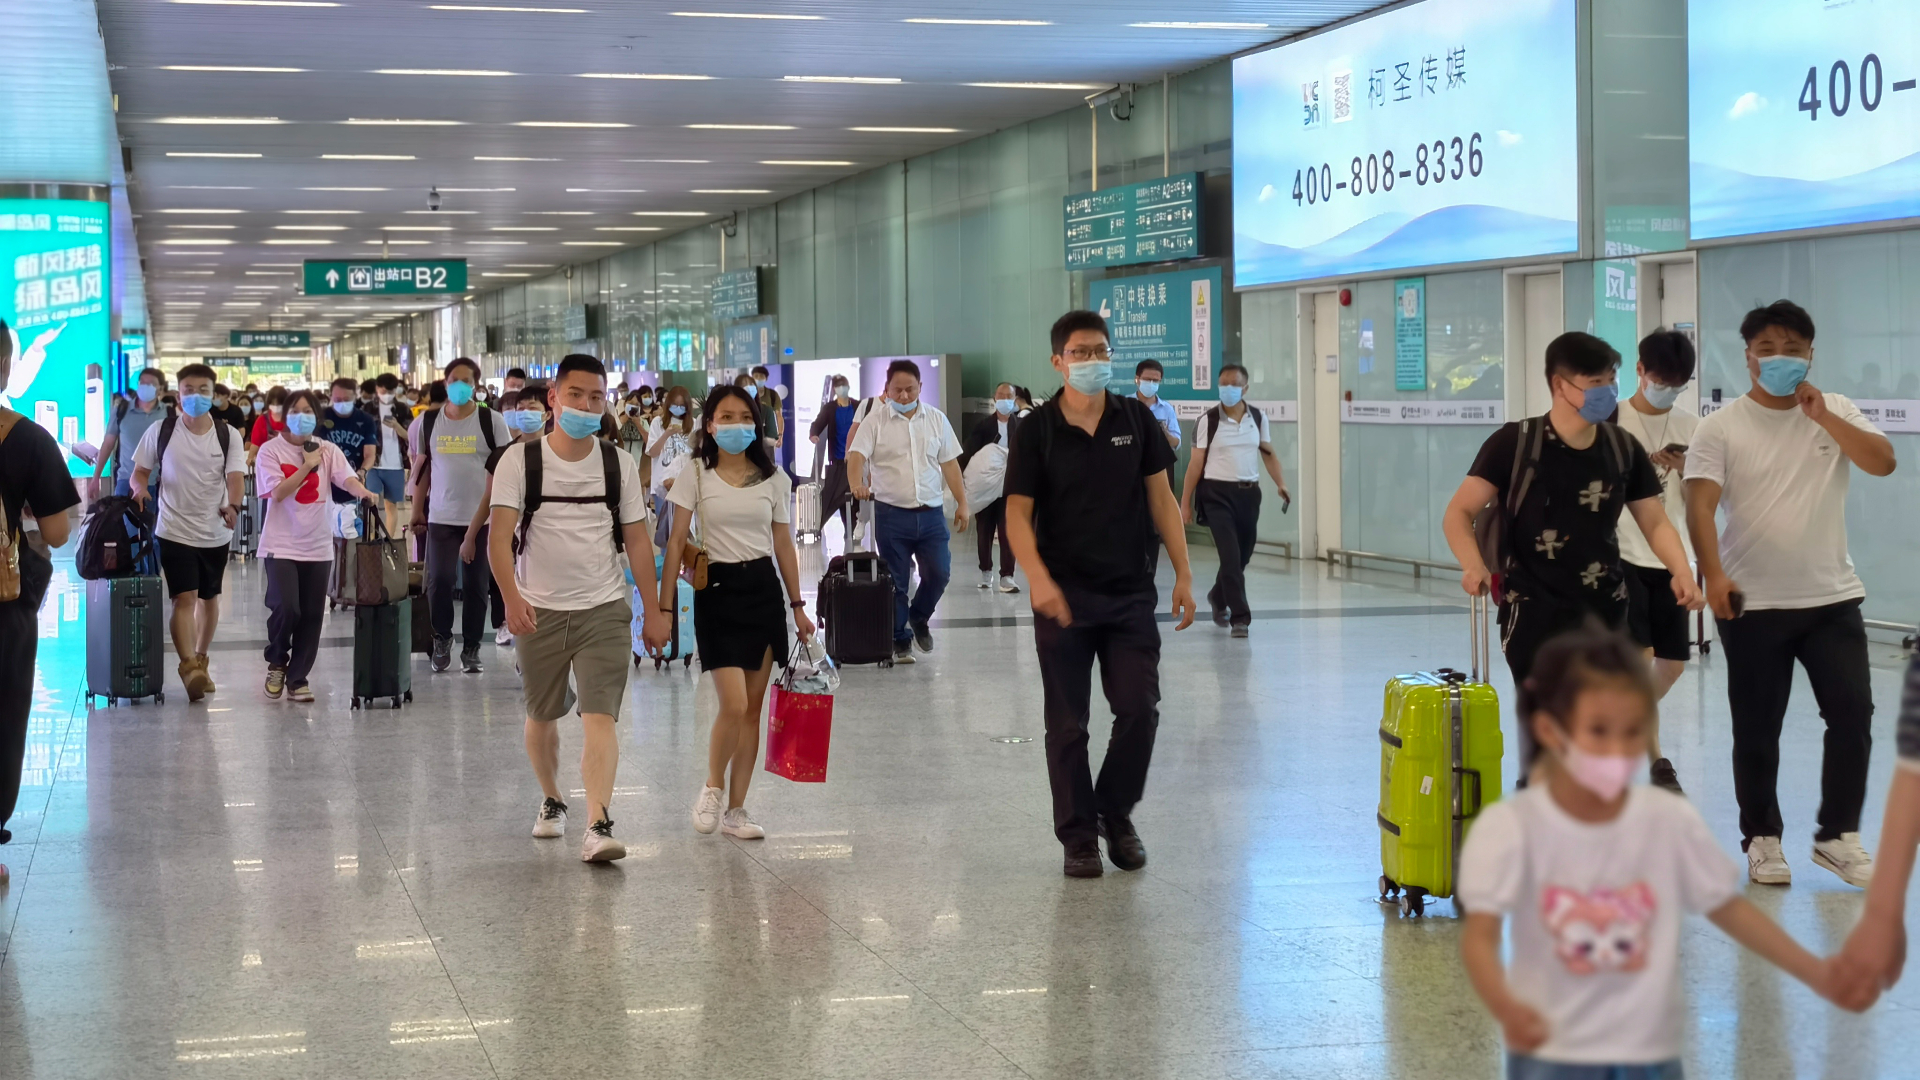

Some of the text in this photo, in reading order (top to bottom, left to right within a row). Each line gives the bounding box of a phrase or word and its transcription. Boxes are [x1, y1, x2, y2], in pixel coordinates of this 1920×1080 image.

[1368, 44, 1466, 109] 柯圣传媒
[1292, 132, 1483, 207] 400-808-8336
[374, 267, 447, 288] 出站口 B2
[1128, 282, 1167, 308] 中转换乘
[1127, 310, 1148, 323] Transfer
